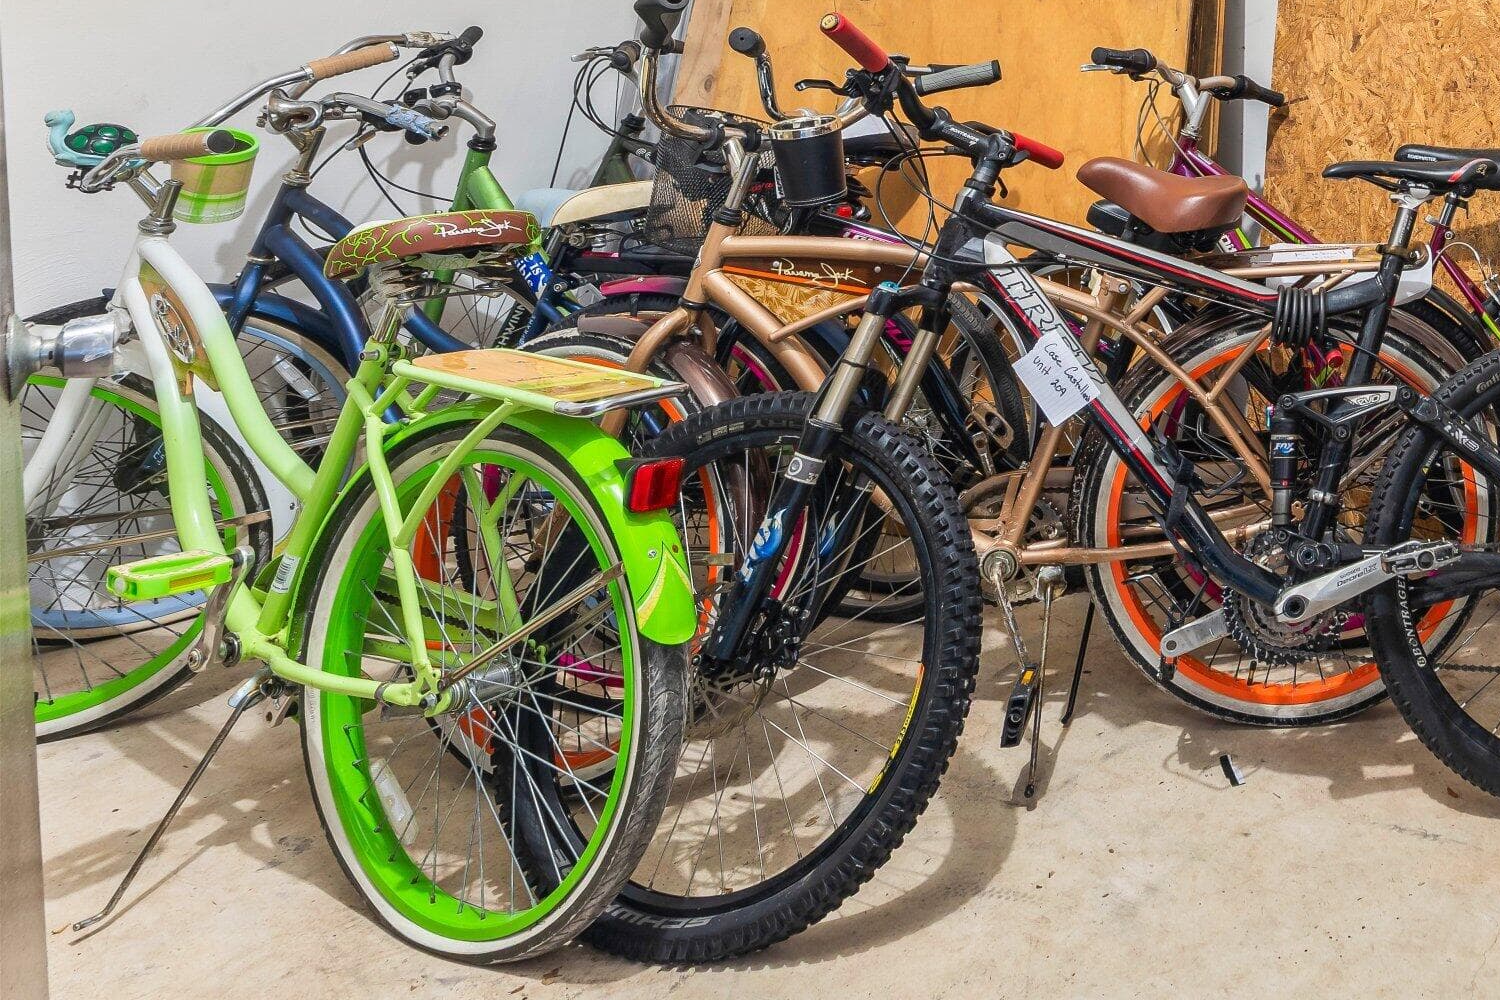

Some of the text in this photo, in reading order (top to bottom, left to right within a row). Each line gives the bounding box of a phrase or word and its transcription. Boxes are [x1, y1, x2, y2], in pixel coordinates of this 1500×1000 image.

[771, 257, 867, 288] Panama Jack
[1274, 442, 1295, 453] FOX
